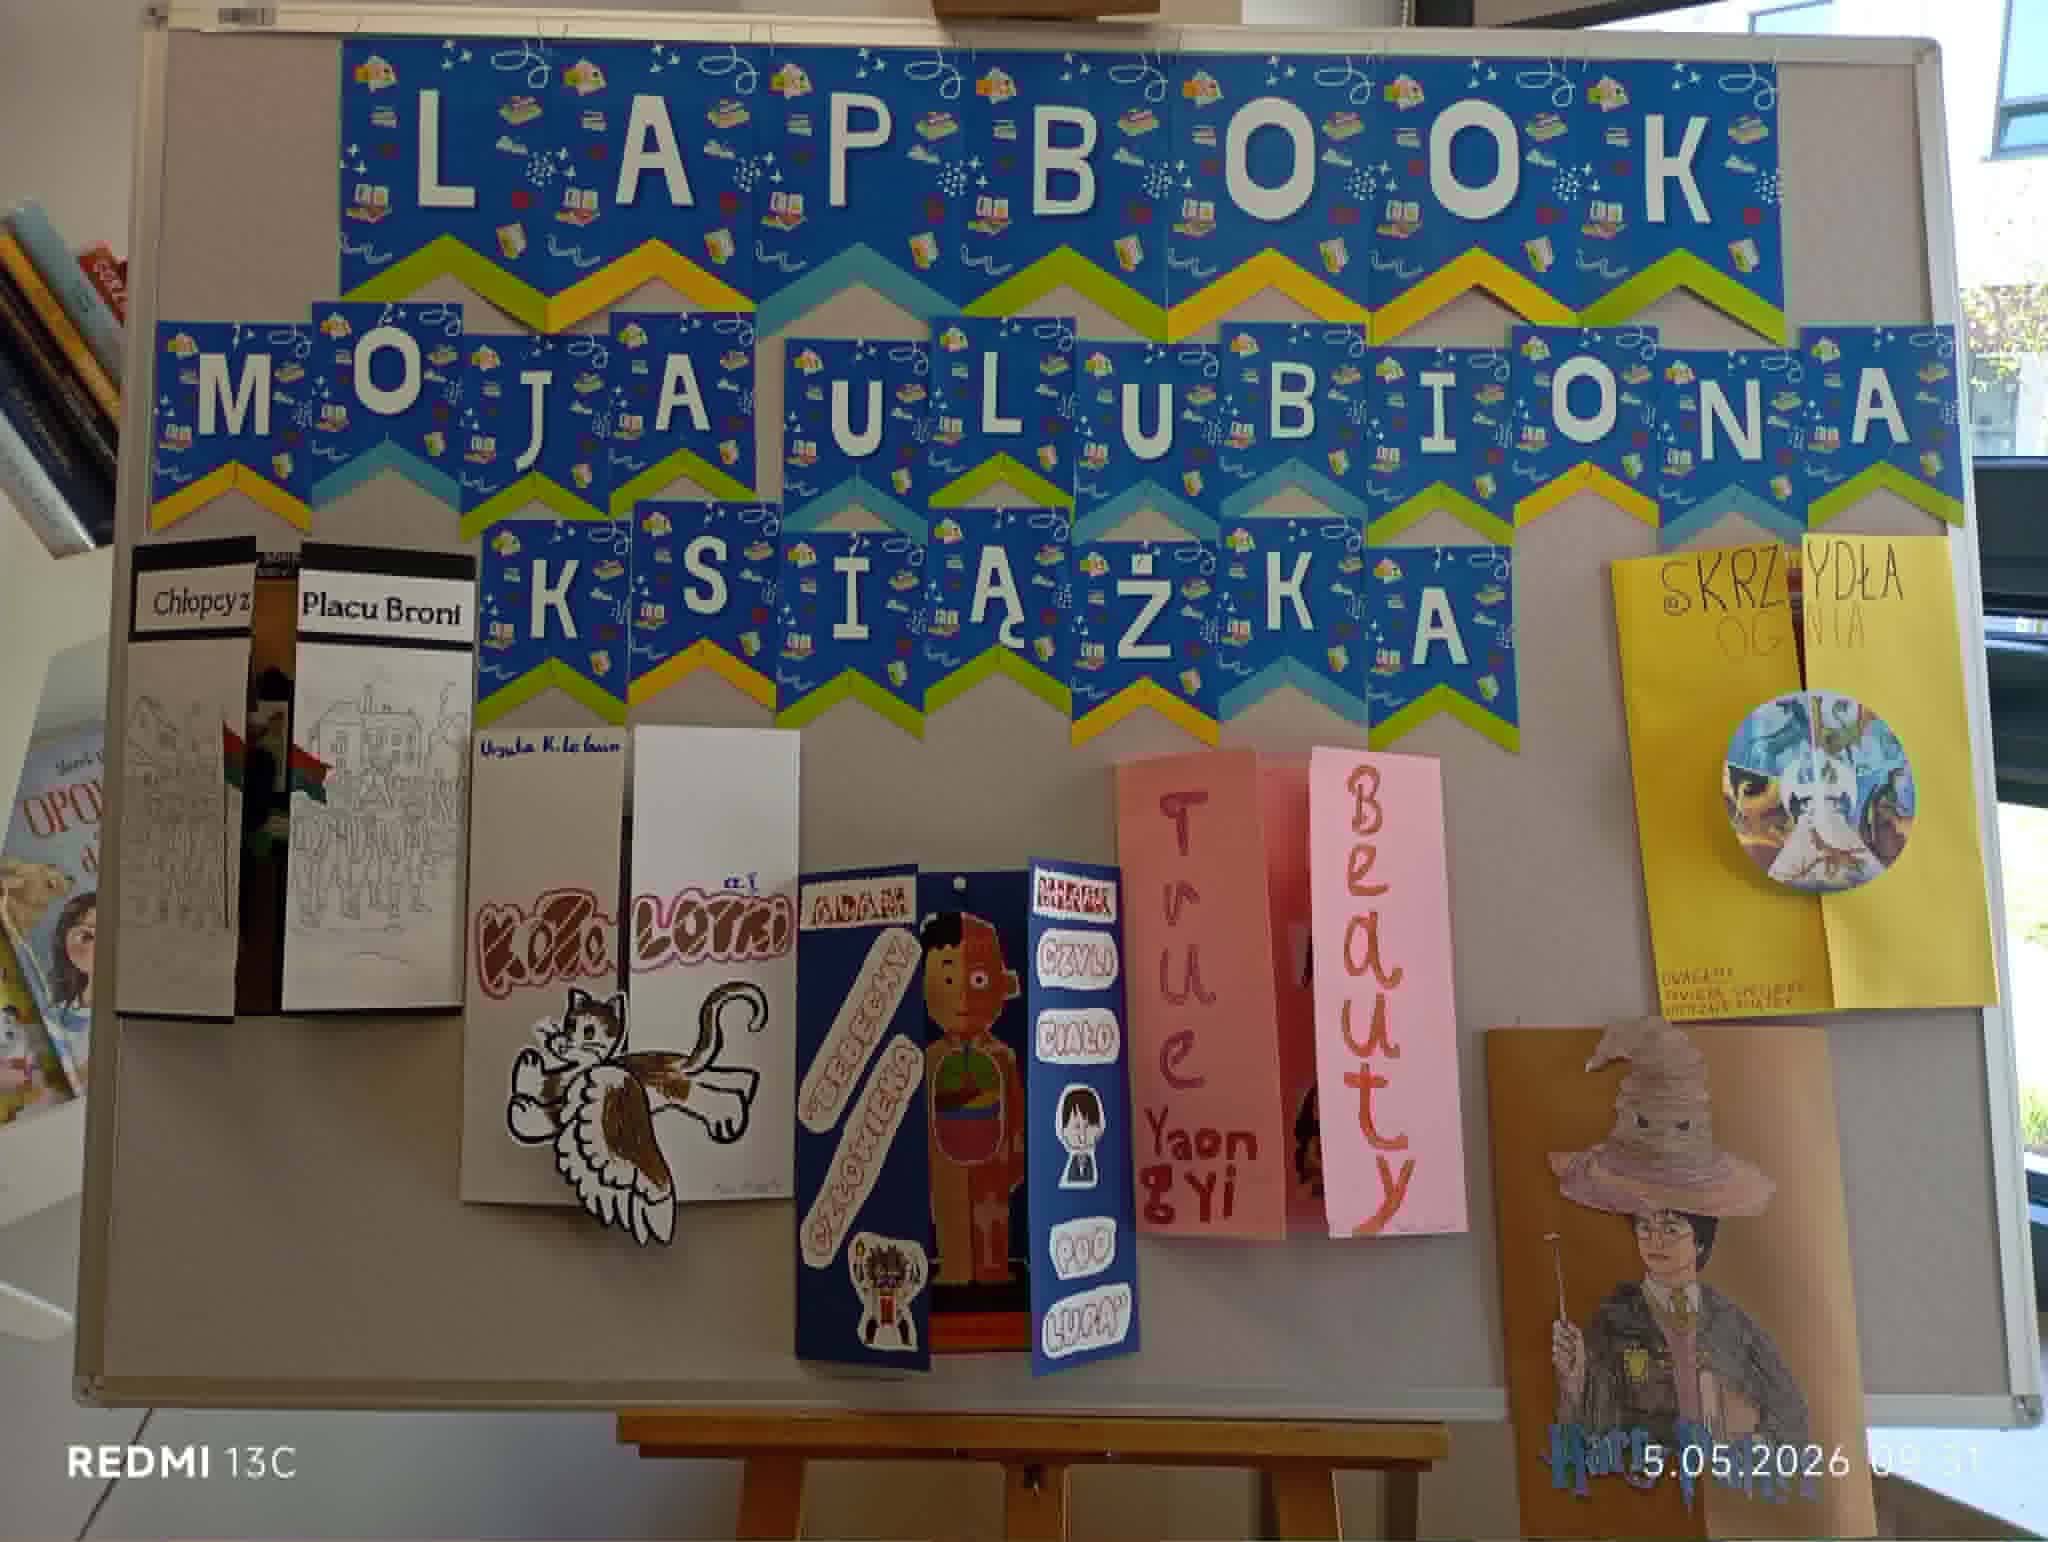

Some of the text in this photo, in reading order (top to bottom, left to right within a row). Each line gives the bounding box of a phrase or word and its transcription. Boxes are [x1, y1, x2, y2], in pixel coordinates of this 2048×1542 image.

[418, 90, 1712, 224] LAPBOOK
[199, 325, 711, 472] MOJA
[831, 351, 1911, 462] ULUBIONA
[303, 591, 378, 621] Placu
[385, 597, 462, 627] Broni
[530, 535, 1469, 666] KSIĄŻKA
[1341, 764, 1416, 1236] Beauty
[1144, 1106, 1259, 1161] Yaon
